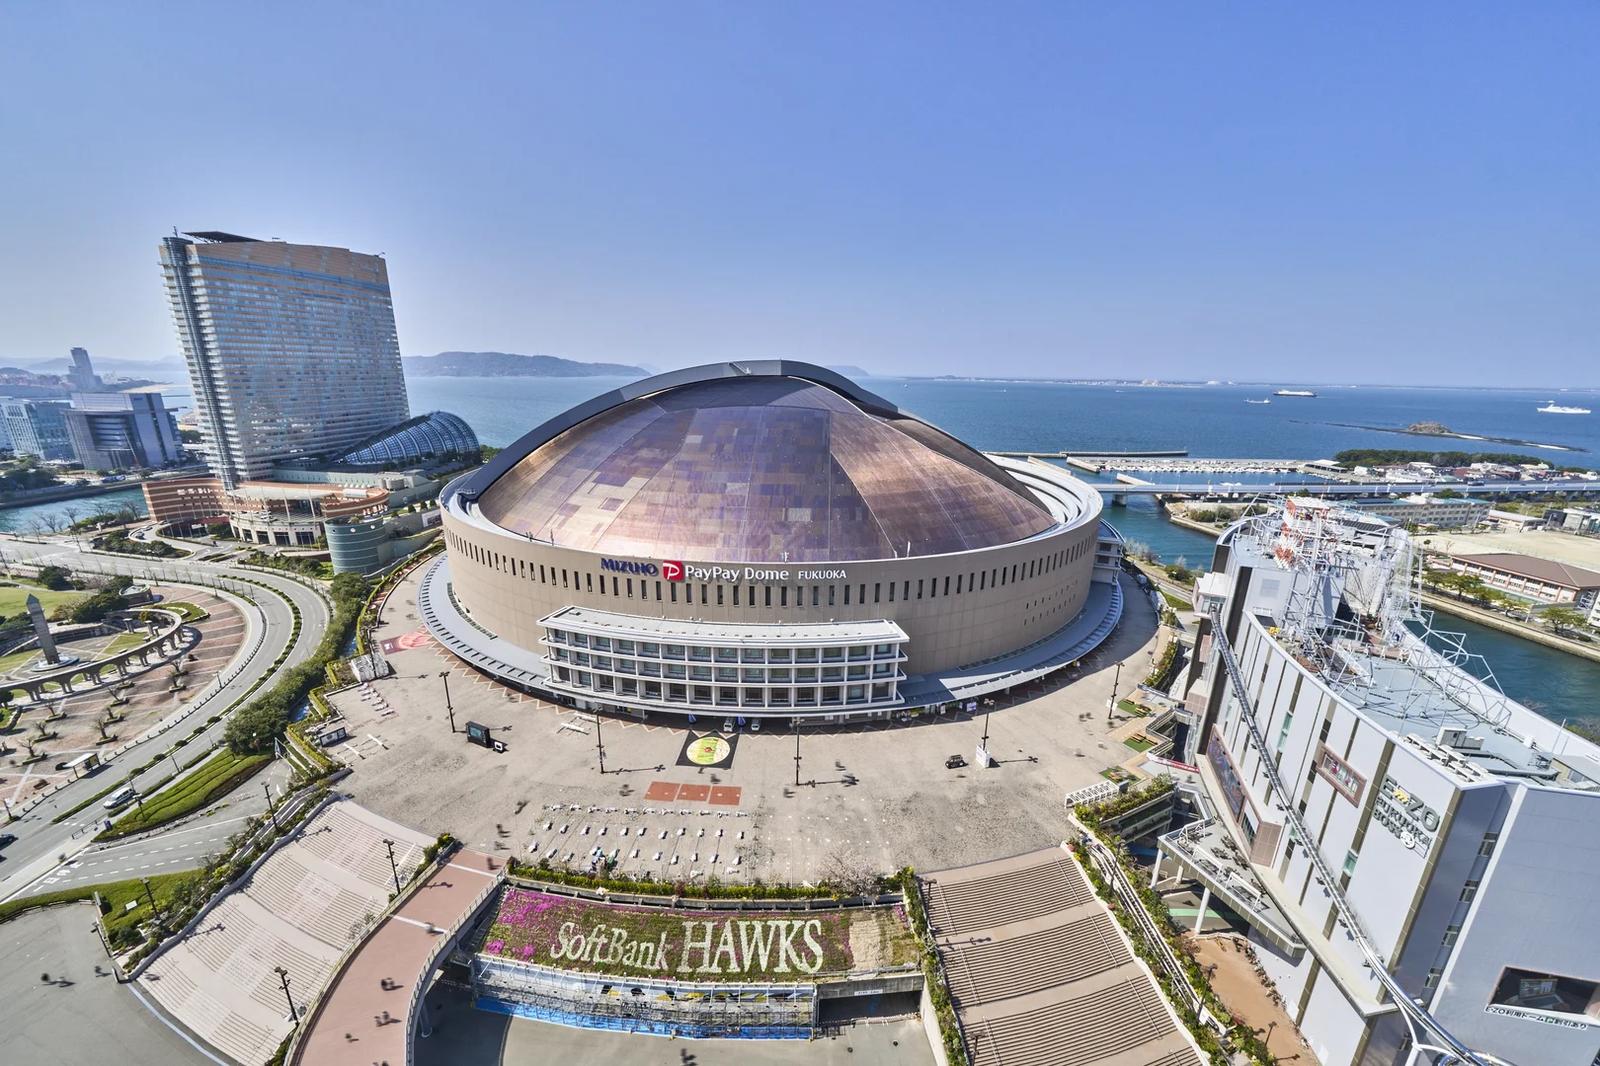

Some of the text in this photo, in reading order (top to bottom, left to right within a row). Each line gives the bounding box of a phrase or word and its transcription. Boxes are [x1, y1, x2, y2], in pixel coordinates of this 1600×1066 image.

[600, 558, 658, 576] MIZUNO
[684, 564, 740, 582] PayPay
[744, 567, 790, 581] Dome
[798, 569, 847, 580] FUKUOKA
[551, 919, 823, 973] SoftBank HAWKS
